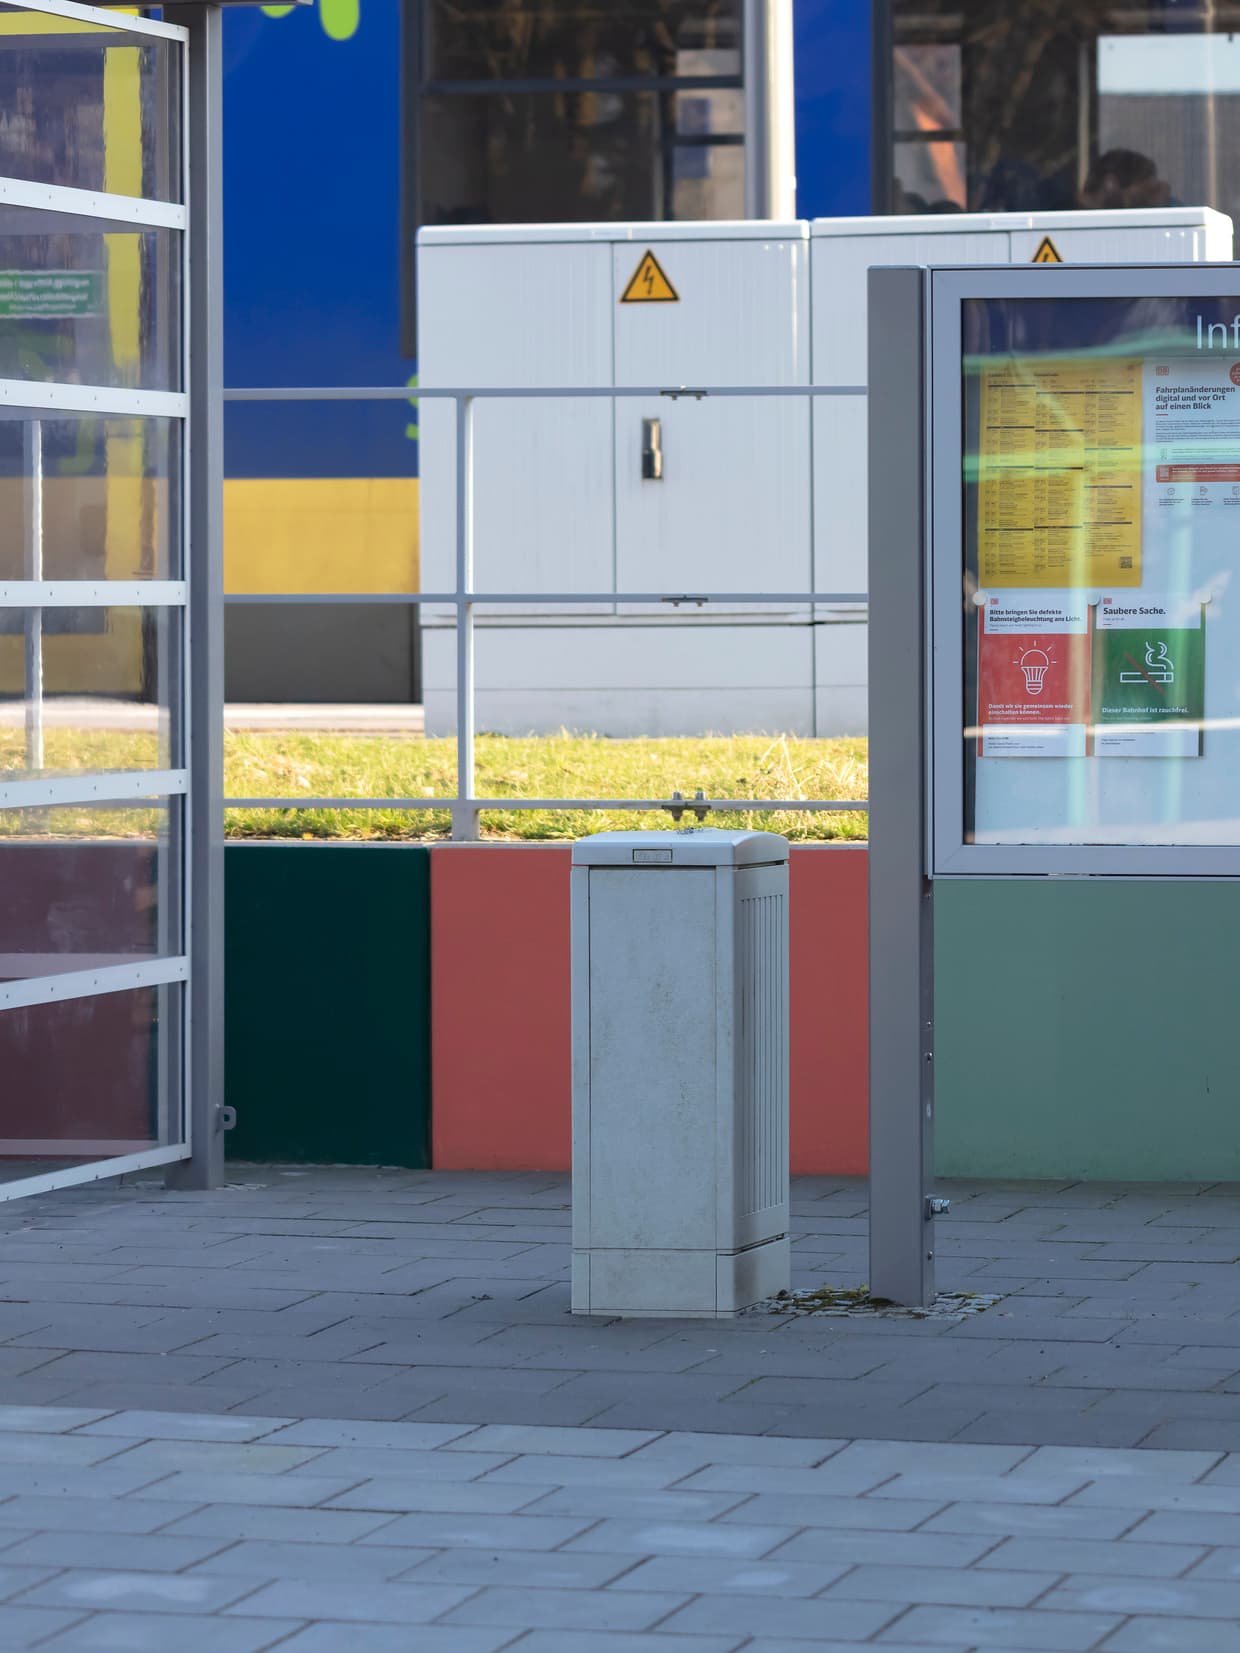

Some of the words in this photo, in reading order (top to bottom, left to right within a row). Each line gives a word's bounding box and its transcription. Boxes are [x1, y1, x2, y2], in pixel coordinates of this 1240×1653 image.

[1155, 386, 1236, 395] Fahrplanänderungen
[1155, 394, 1180, 402] digital
[1193, 402, 1212, 410] Blick
[1103, 607, 1137, 615] Saubere
[1139, 607, 1166, 615] Sache.
